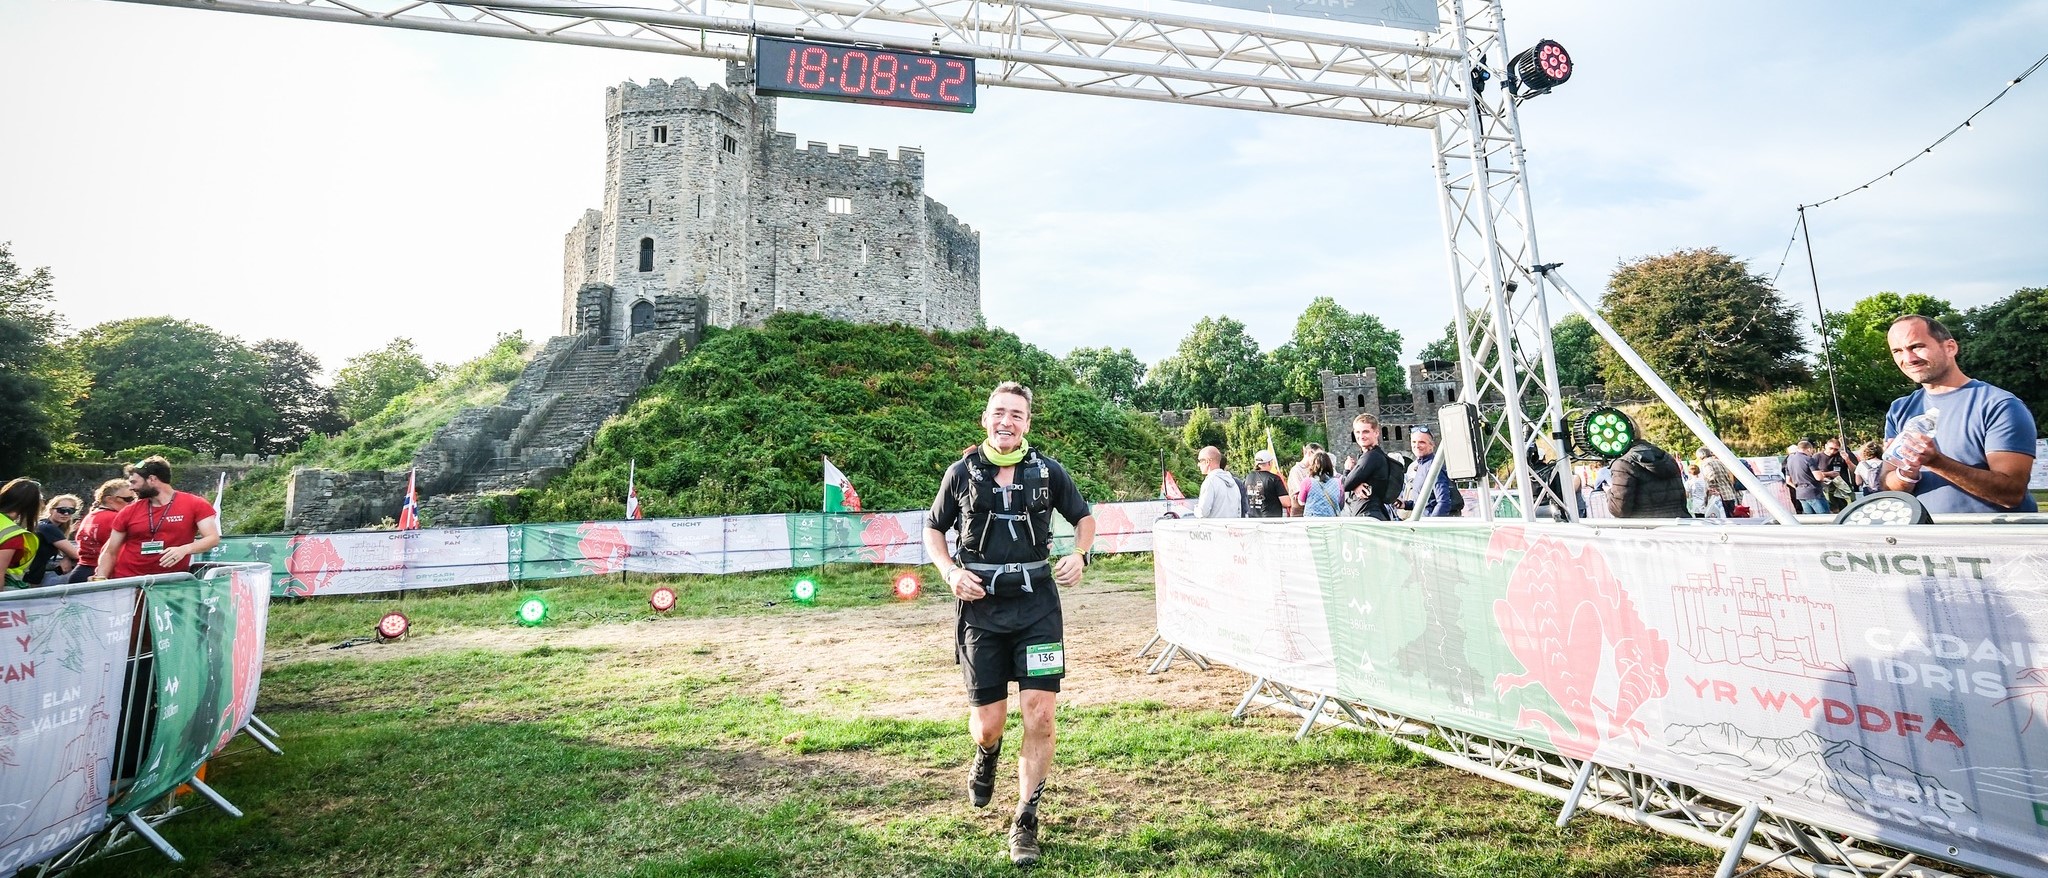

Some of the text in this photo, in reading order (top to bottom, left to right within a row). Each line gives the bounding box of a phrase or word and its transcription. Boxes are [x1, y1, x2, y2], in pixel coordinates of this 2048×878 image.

[786, 46, 967, 102] 18:08:22
[388, 533, 421, 541] CNICHT
[1188, 530, 1213, 542] CNICHT
[1232, 554, 1248, 565] FAN
[1342, 541, 1353, 562] 6
[1341, 565, 1361, 578] days
[1819, 550, 1993, 580] CNICHT
[154, 606, 165, 633] 6
[16, 633, 32, 653] Y
[1037, 652, 1055, 663] 136
[1870, 657, 2009, 700] IDRIS
[42, 685, 82, 709] ELAN
[31, 704, 88, 733] VALLEY
[1684, 674, 1966, 749] YR WYDDFA
[1870, 773, 1967, 814] CRIB
[0, 813, 103, 873] CARDIFF
